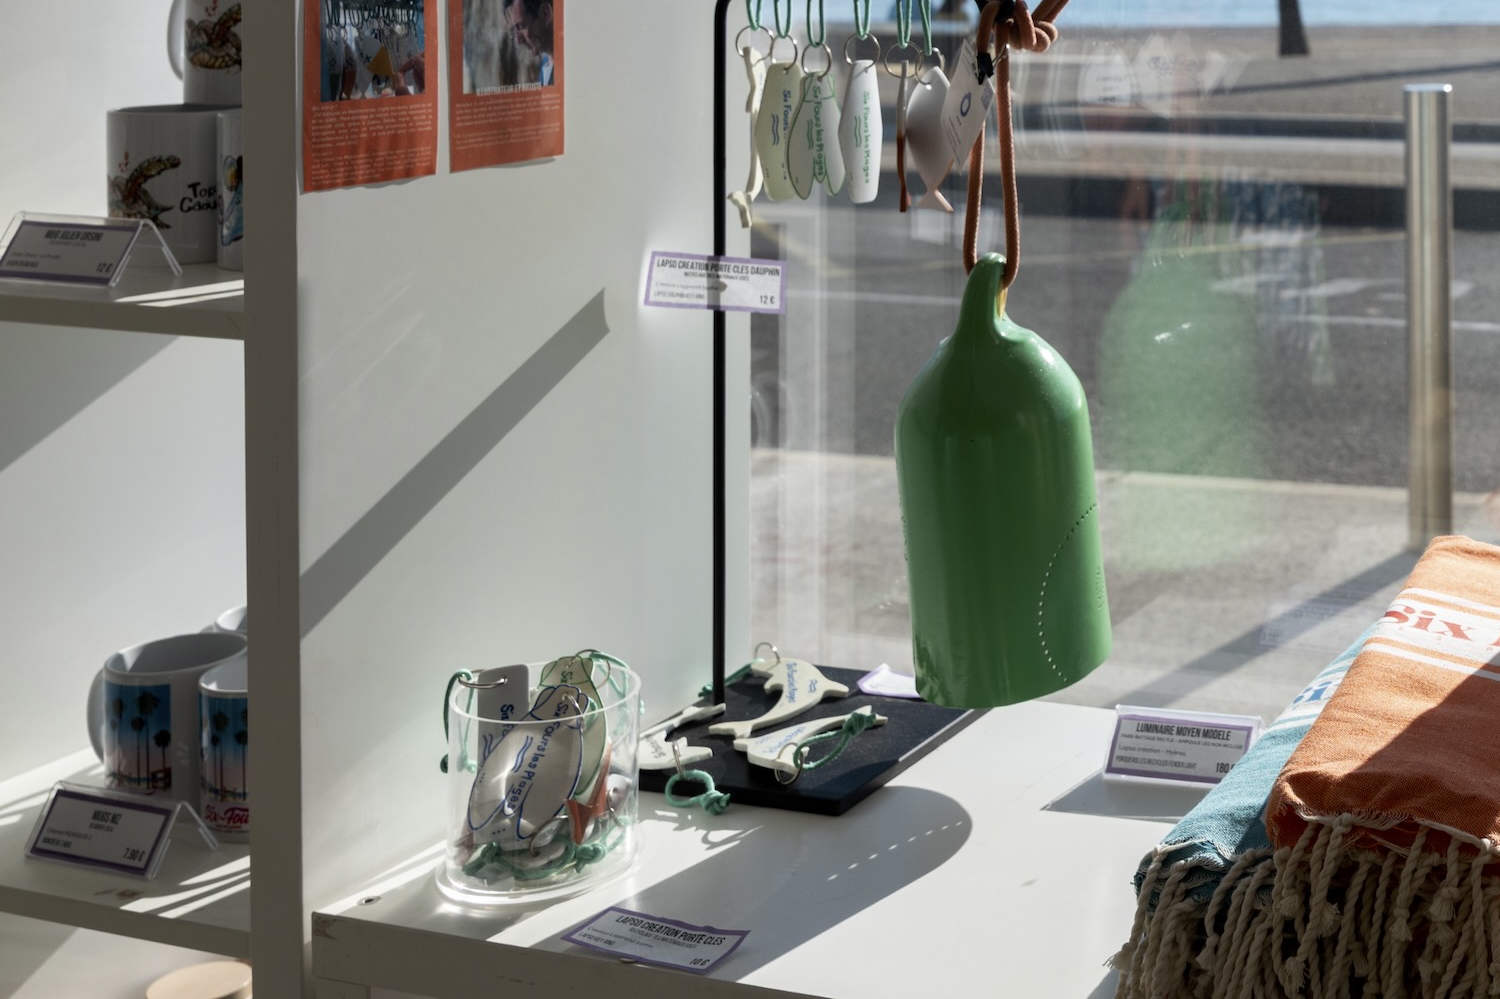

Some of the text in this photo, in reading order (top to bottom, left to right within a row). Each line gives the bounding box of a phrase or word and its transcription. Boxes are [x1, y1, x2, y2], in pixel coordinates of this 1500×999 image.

[657, 258, 780, 276] LAPSO CREATION PORTE CLES DAUPHIN
[760, 295, 775, 304] 12 €
[1377, 604, 1478, 642] Six
[1136, 721, 1232, 741] LUMINAIRE MOYEN MODELE
[506, 702, 569, 811] Six Fours les Plages
[1118, 744, 1136, 754] Lapso
[1215, 762, 1229, 774] 180
[615, 915, 642, 928] LAPSO
[640, 919, 681, 939] CREATION
[679, 931, 705, 944] PORTE
[703, 935, 726, 946] CLES
[689, 957, 710, 967] 10 €
